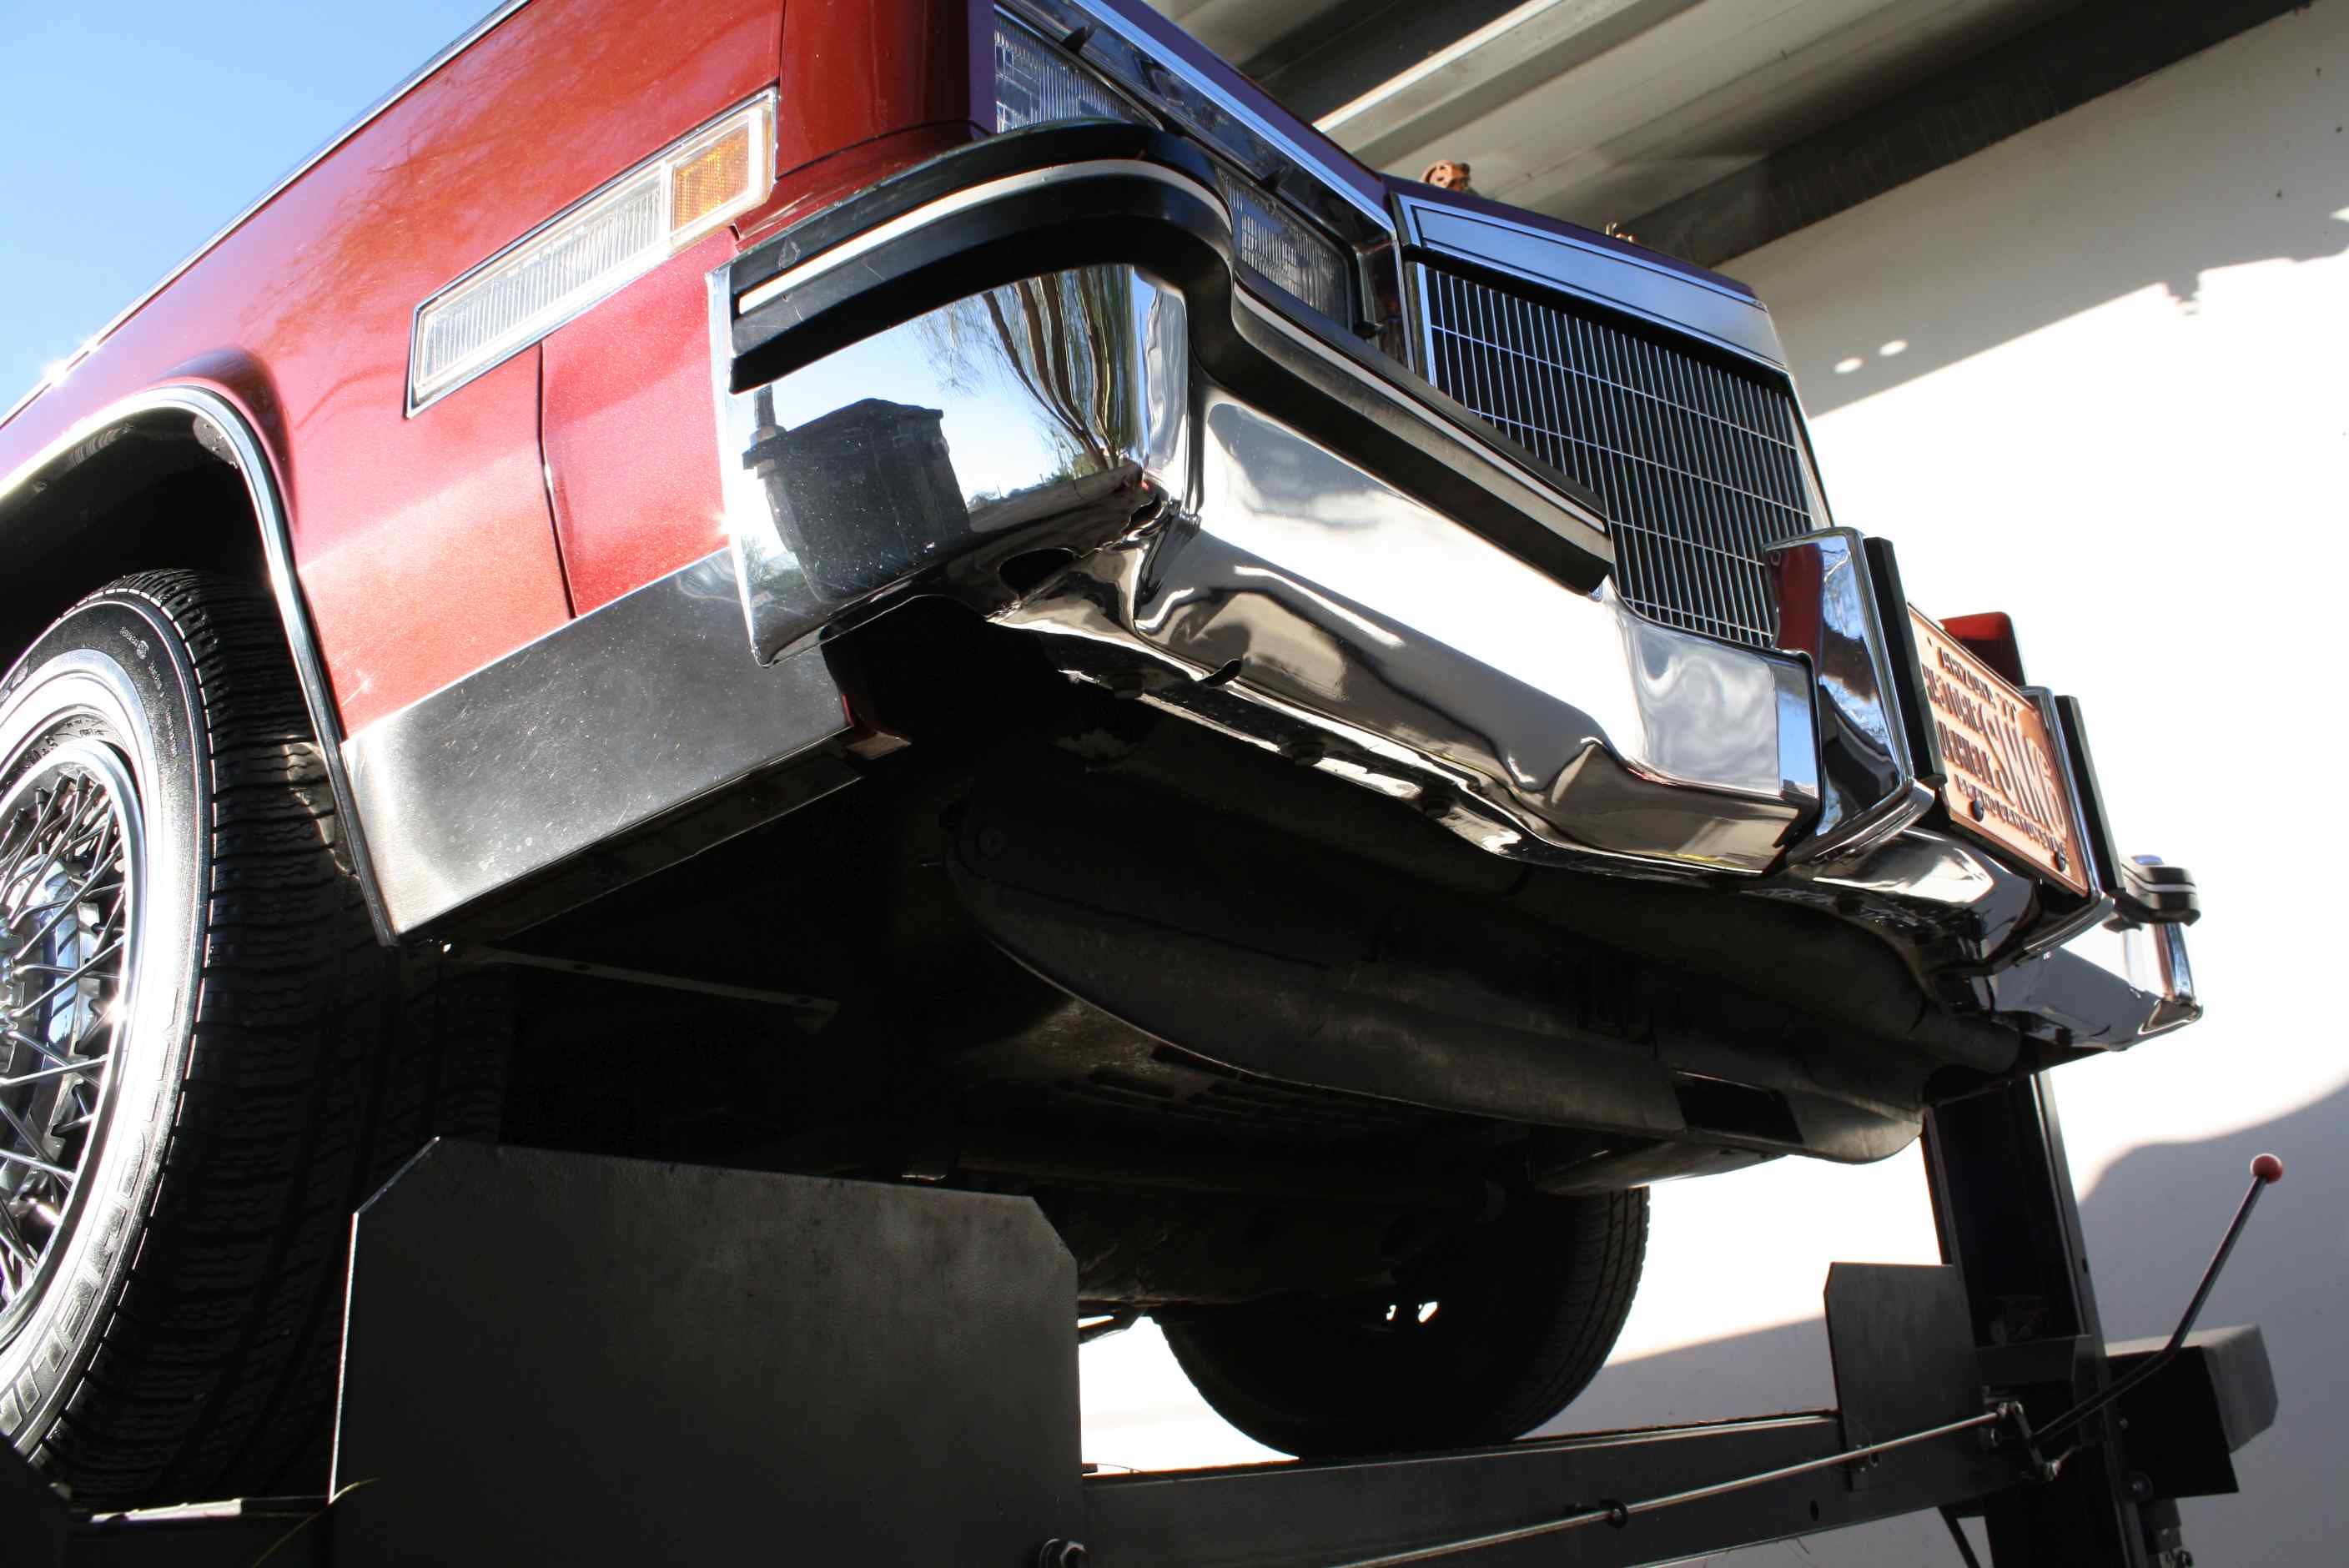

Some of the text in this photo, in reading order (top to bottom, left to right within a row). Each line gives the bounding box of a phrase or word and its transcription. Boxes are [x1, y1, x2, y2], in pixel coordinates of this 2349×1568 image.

[1935, 645, 1998, 710] ARIZONA
[1934, 718, 1999, 791] VEHICLE
[0, 988, 179, 1436] CHELI
